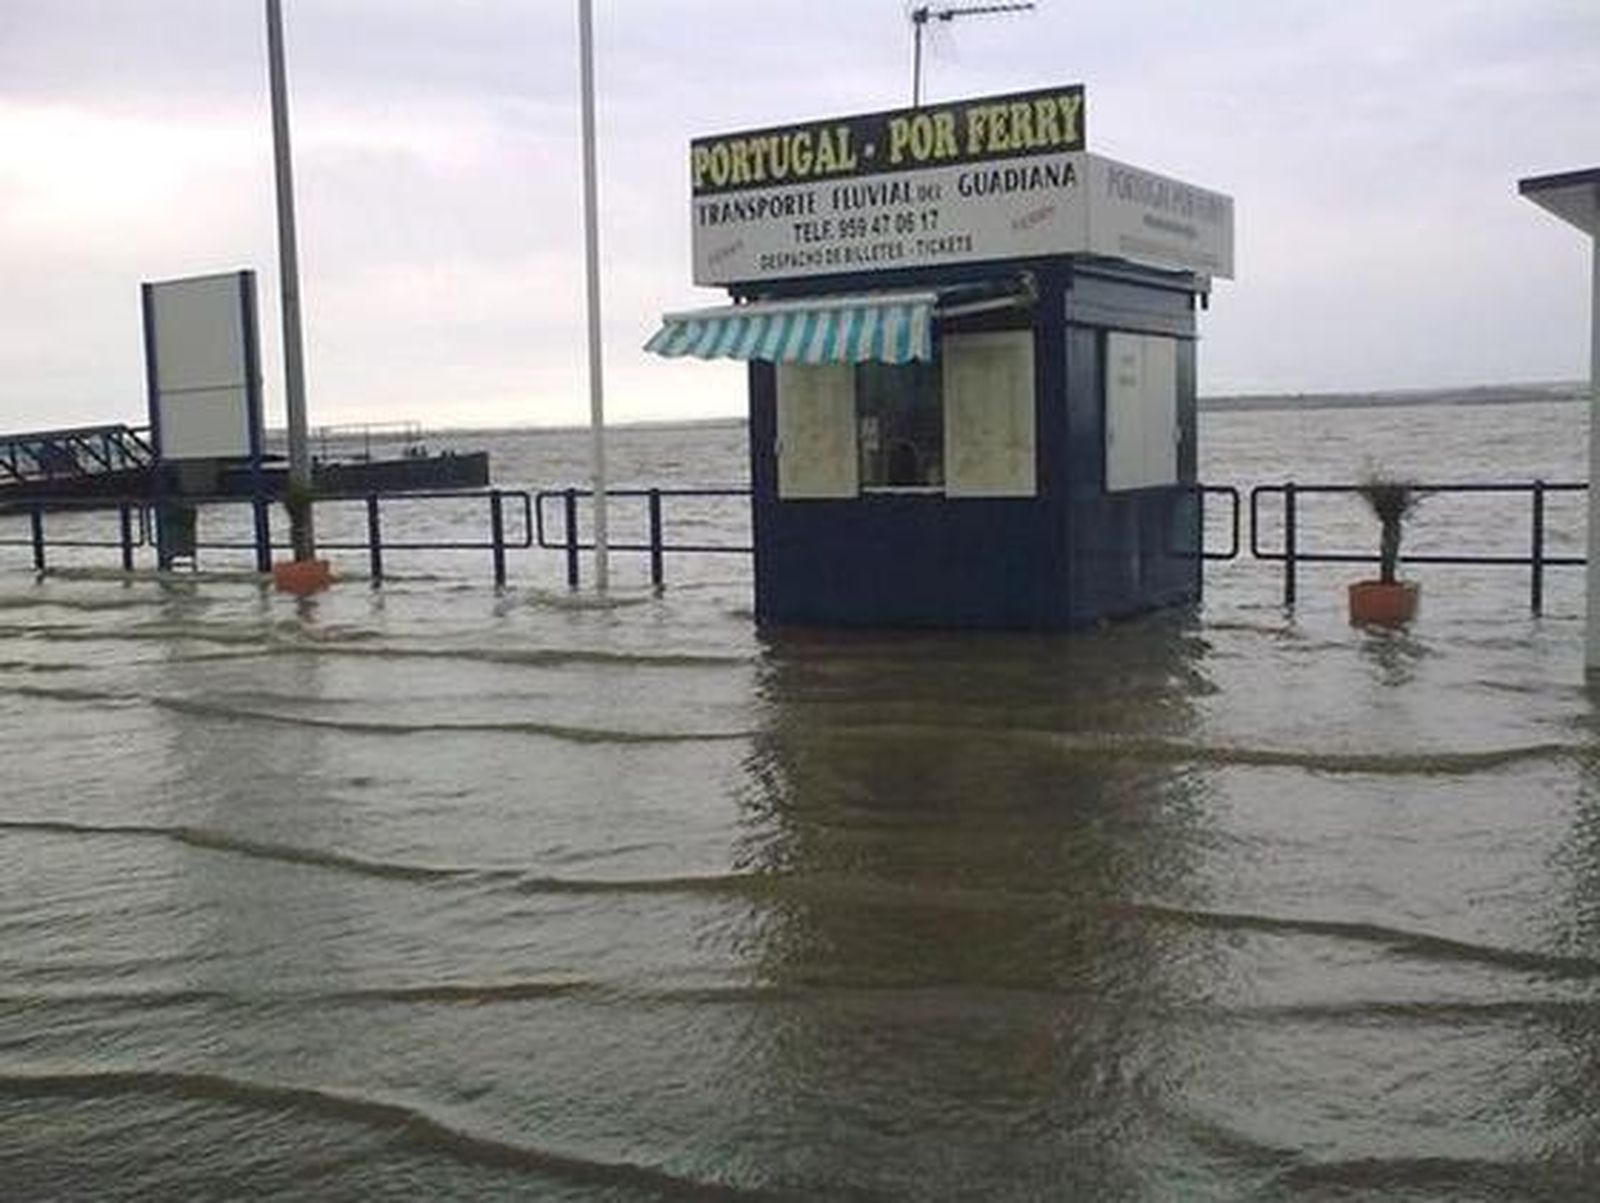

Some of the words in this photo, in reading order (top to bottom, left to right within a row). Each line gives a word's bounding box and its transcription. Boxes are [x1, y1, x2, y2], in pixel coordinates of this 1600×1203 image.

[693, 128, 857, 187] PORTUGAL
[889, 111, 958, 163] POR
[966, 96, 1081, 153] FERRY
[699, 191, 816, 226] TRANSPORTE
[832, 181, 912, 210] FLUVIAL
[958, 162, 1077, 198] GUADIANA
[838, 216, 867, 239] 959
[871, 213, 891, 234] 47
[919, 208, 939, 231] 17
[759, 249, 823, 271] DESPACHO
[844, 240, 904, 264] BILLETES
